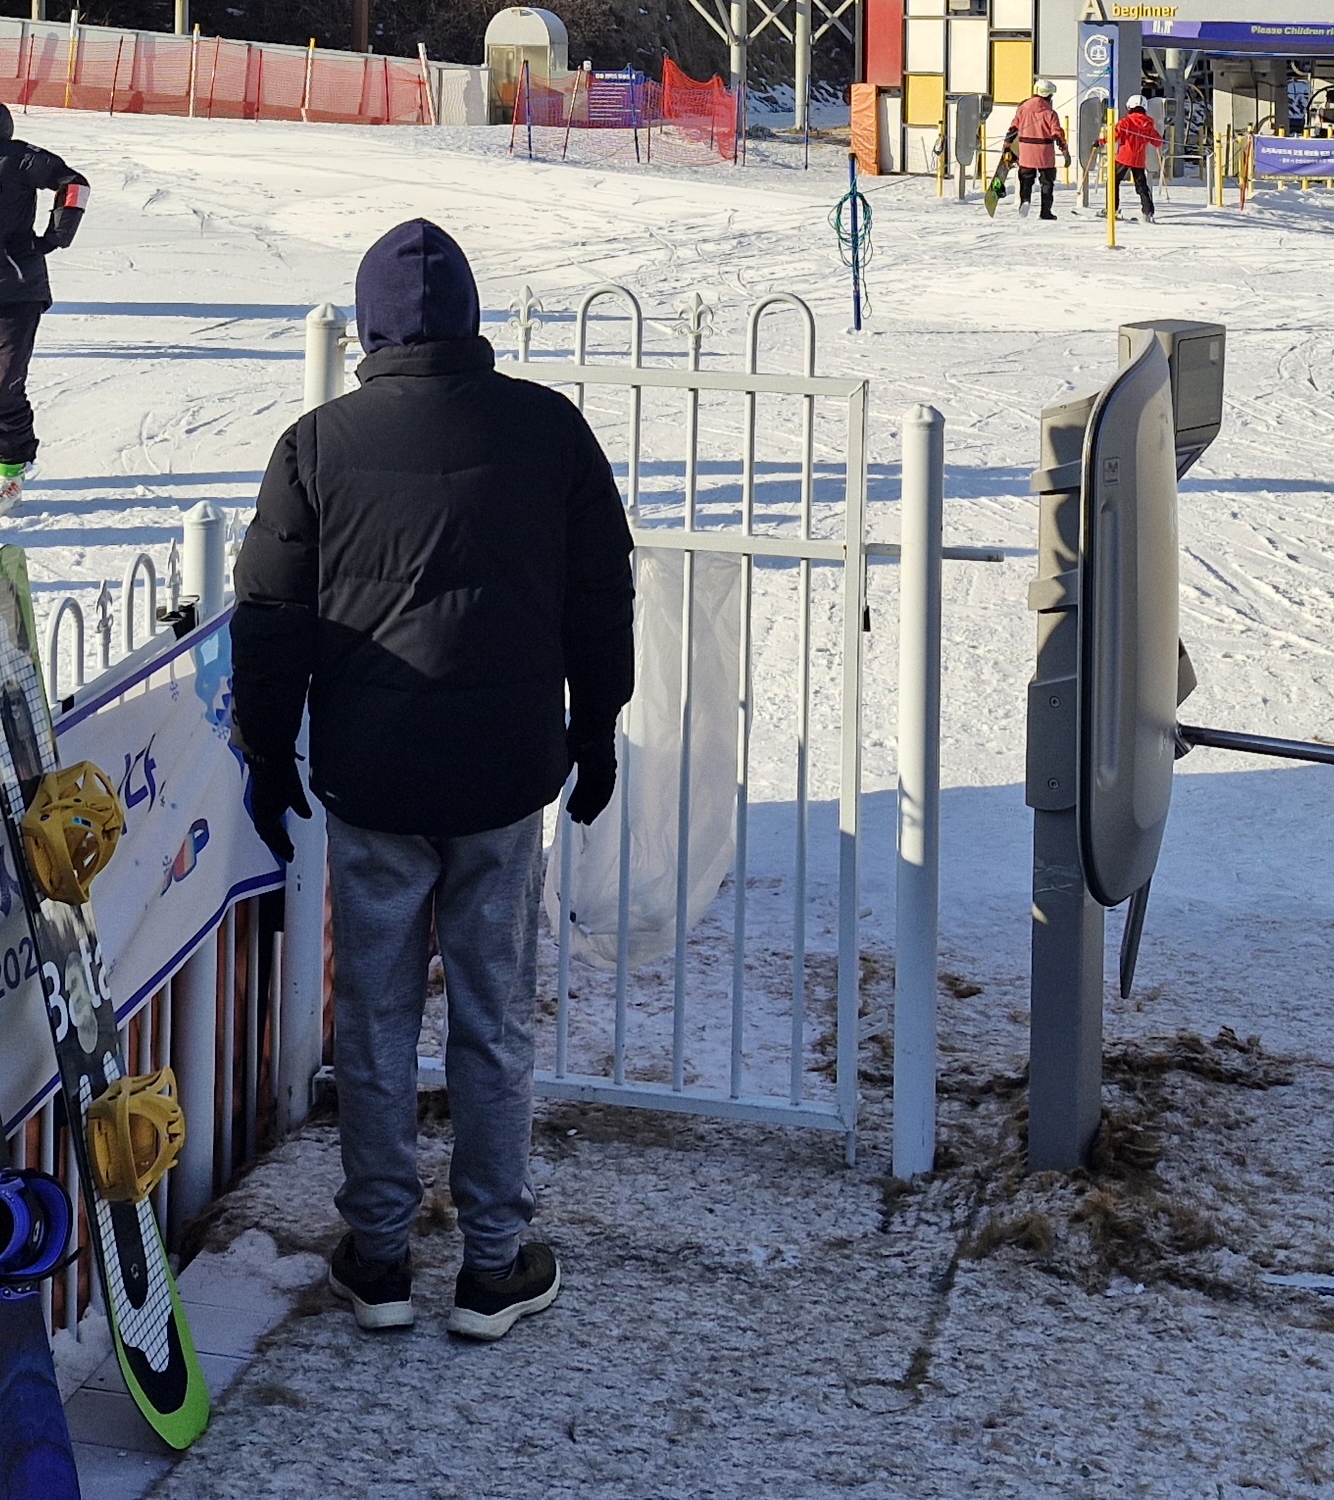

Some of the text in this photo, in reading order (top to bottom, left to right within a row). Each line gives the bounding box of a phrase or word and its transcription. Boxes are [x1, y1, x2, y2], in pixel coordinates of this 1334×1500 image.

[1111, 2, 1178, 18] beginner
[1251, 25, 1283, 35] Please
[1284, 26, 1324, 36] Children
